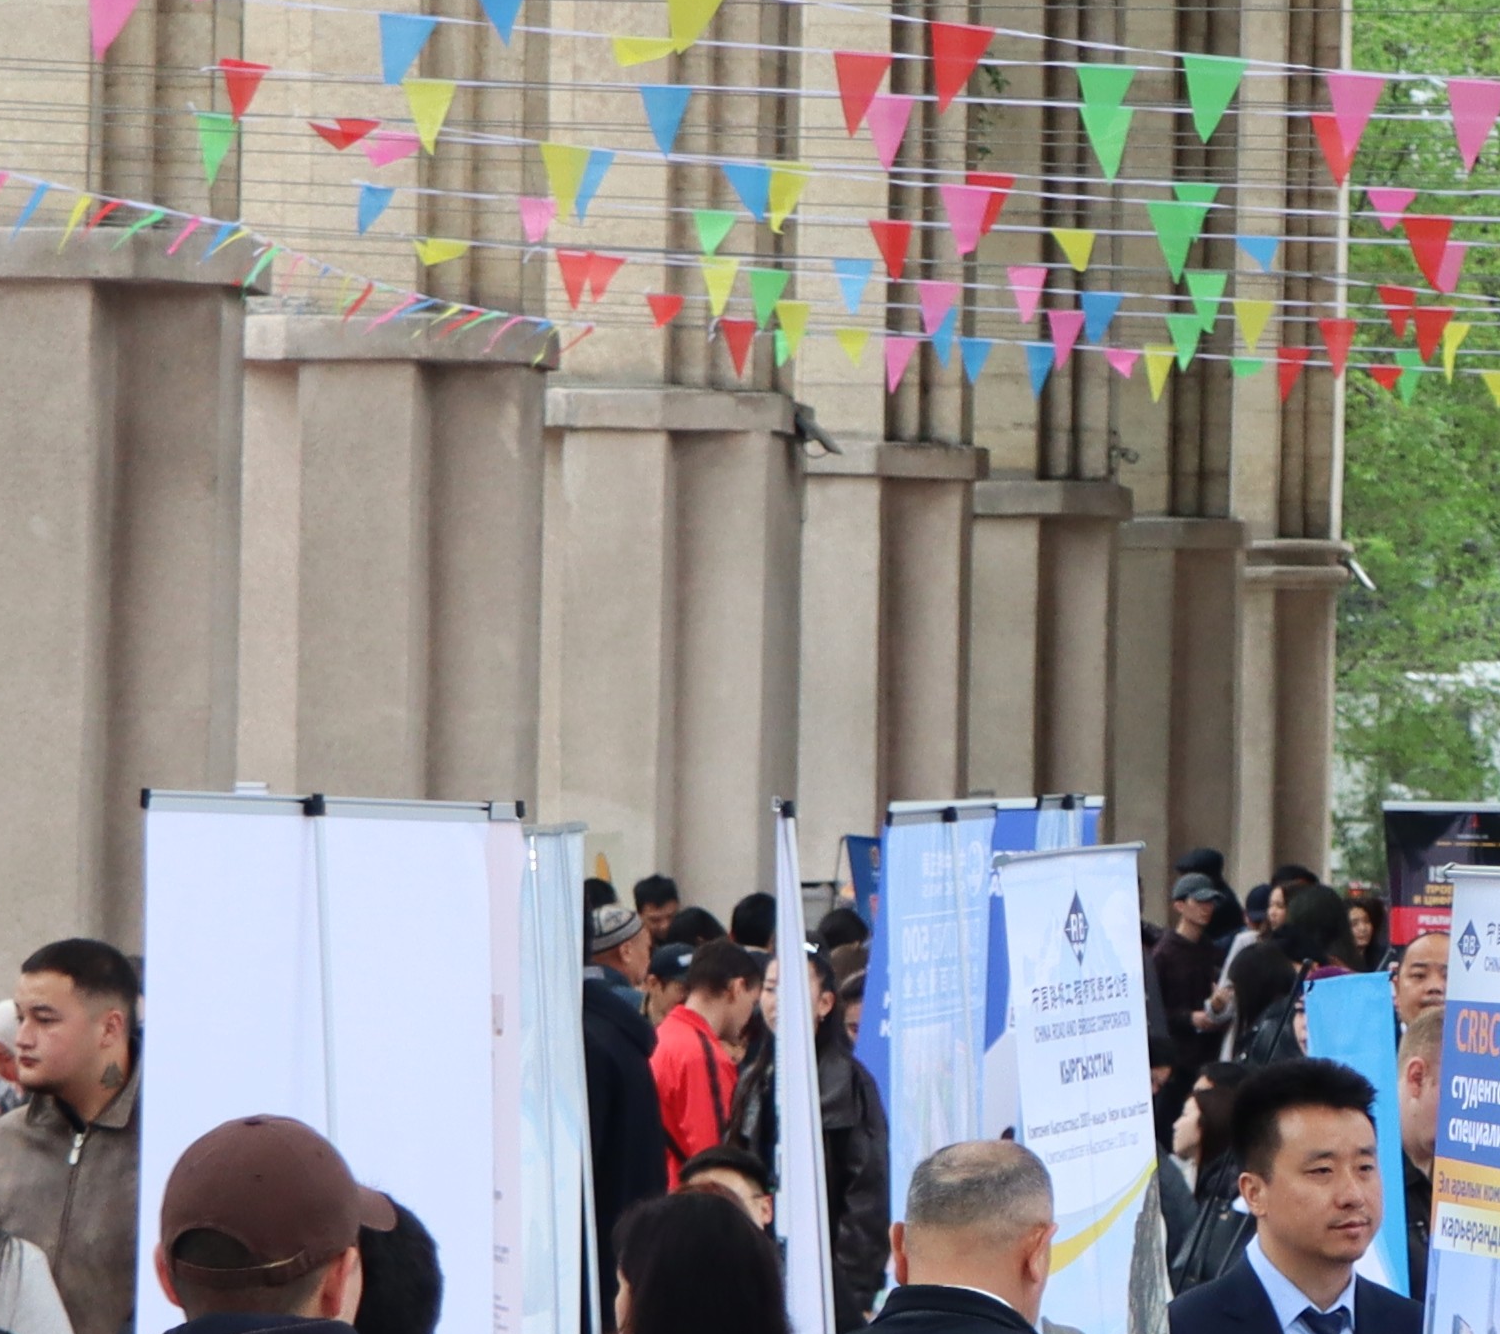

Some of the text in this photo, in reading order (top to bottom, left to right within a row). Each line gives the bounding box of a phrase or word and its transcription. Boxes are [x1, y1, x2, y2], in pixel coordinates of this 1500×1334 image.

[1059, 1051, 1114, 1085] КЫРГЫЗСТАН
[1438, 1171, 1450, 1193] Эл
[1451, 1179, 1482, 1202] аралык
